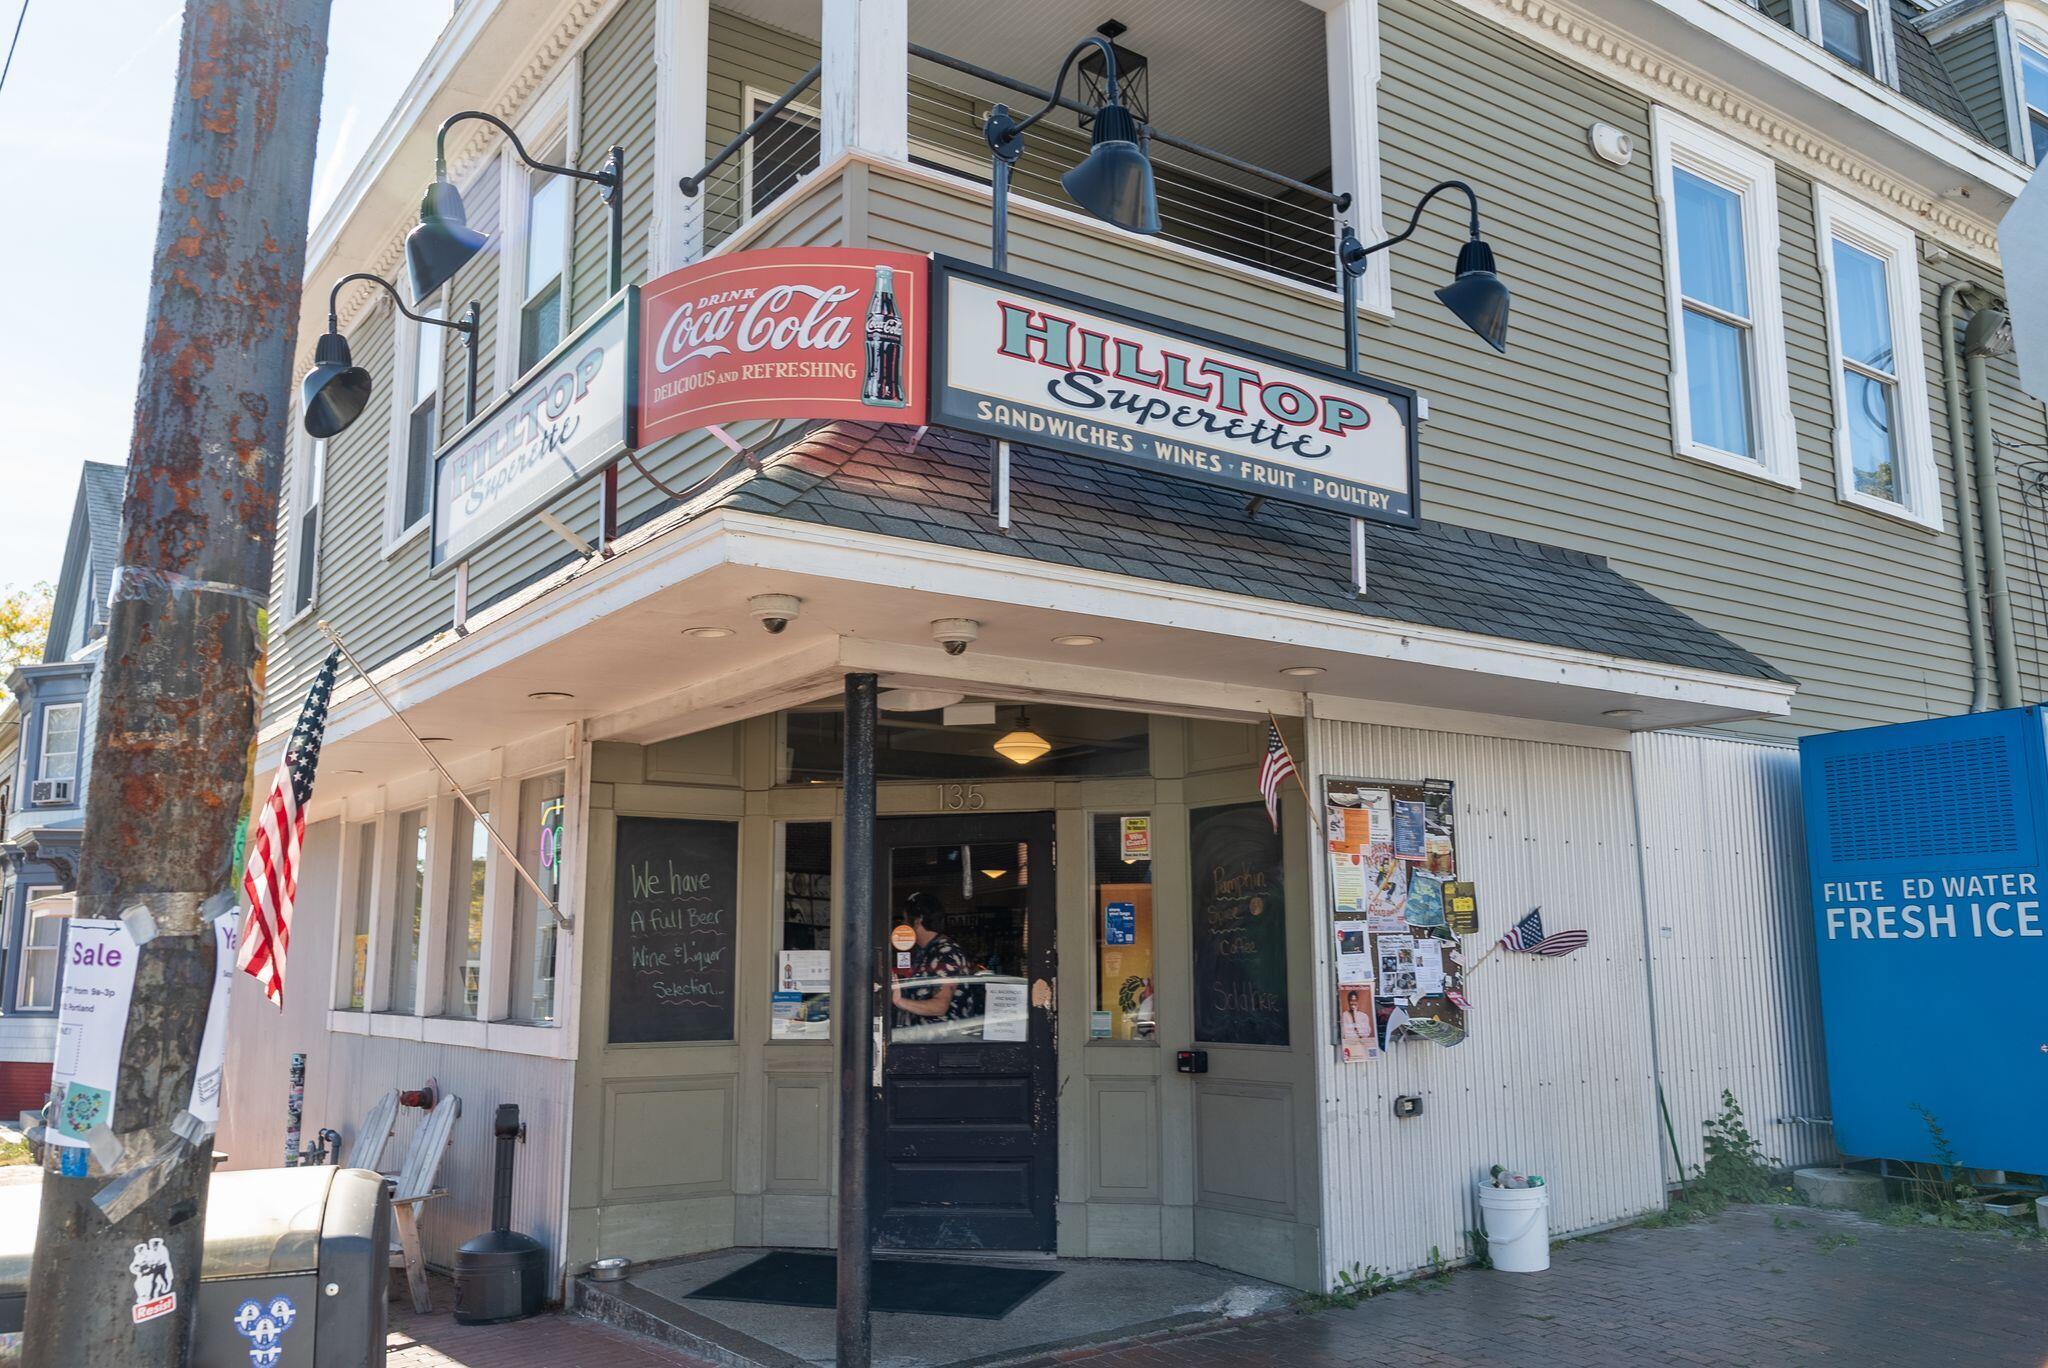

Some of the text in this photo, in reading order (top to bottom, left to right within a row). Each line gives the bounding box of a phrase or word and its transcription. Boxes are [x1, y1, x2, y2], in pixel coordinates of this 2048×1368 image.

[696, 287, 759, 310] DRINK
[655, 284, 860, 374] Coca-Cola
[653, 361, 857, 404] DELICIOUS AND REFRESHING
[996, 299, 1372, 439] HILLTOP
[452, 346, 604, 499] HILLTOP
[1046, 370, 1332, 459] Superette
[464, 414, 580, 516] Superette
[976, 400, 1391, 511] SANDWICHES WINES FRUIT POULTRY
[936, 783, 985, 810] 135
[631, 859, 713, 899] We have
[1941, 872, 2038, 899] WATER
[630, 910, 645, 933] A
[687, 908, 725, 928] Beer
[1826, 901, 2044, 940] FRESH ICE
[72, 941, 123, 968] Sale
[632, 945, 671, 969] Wine
